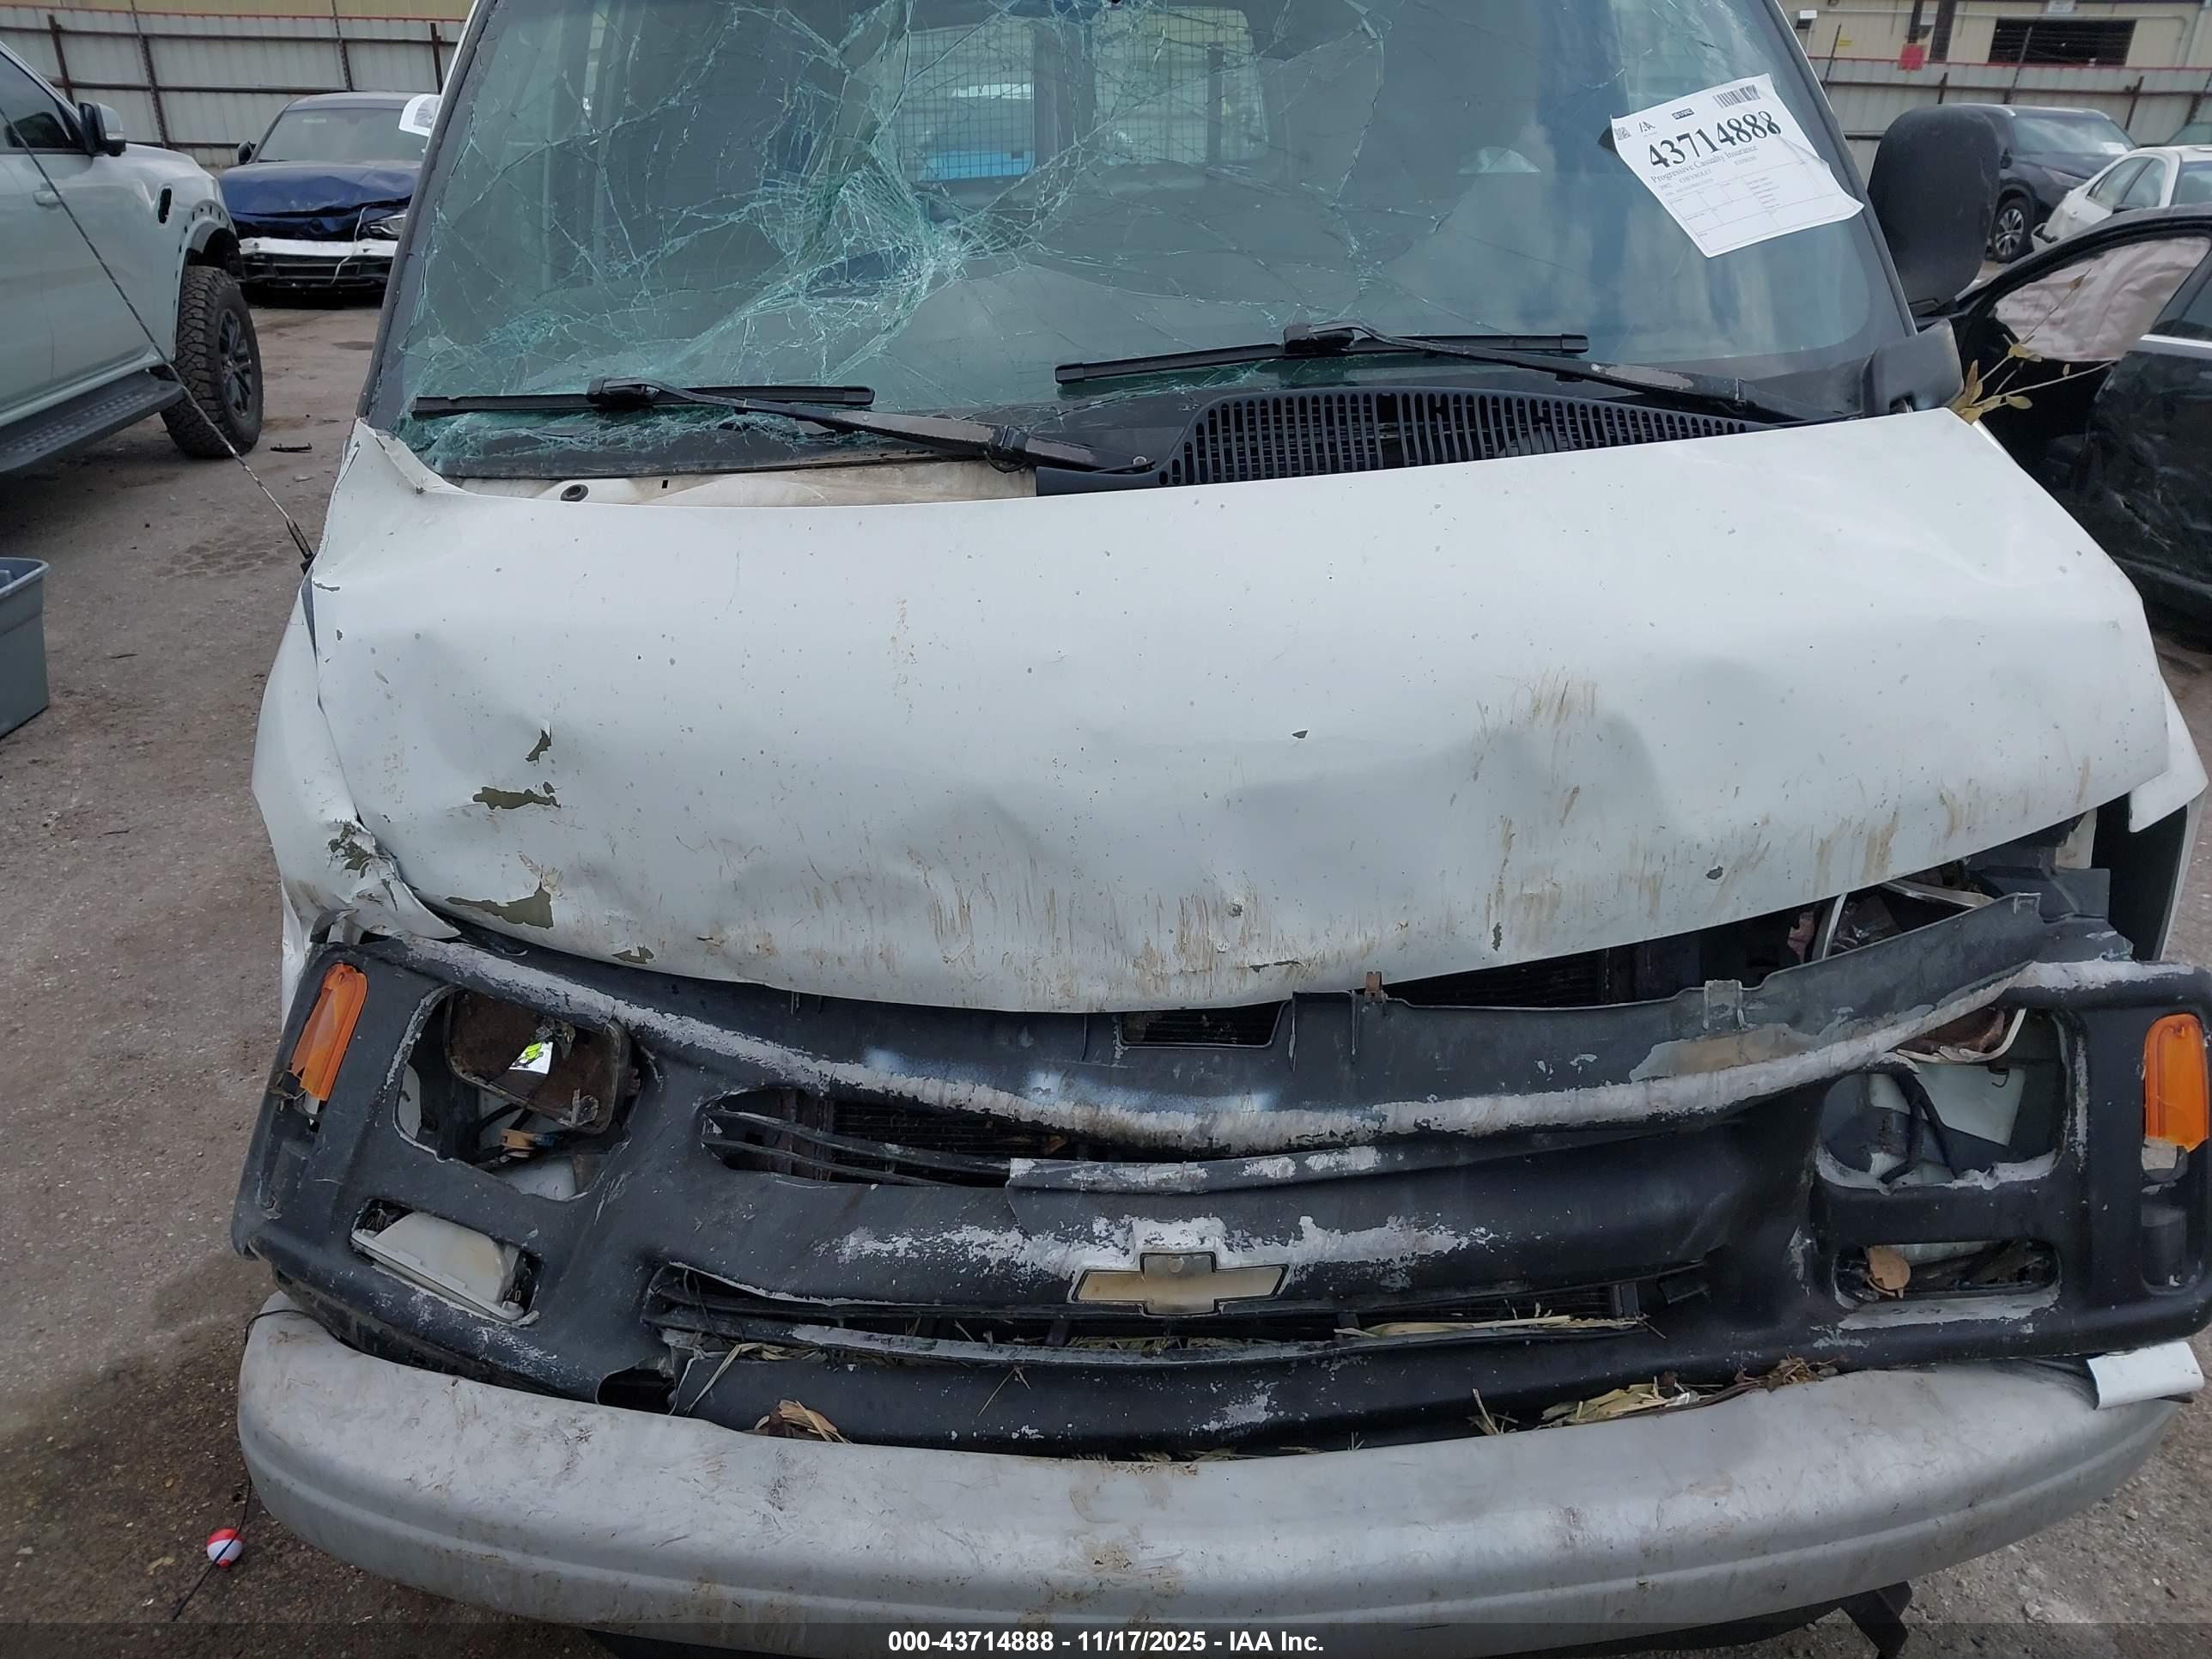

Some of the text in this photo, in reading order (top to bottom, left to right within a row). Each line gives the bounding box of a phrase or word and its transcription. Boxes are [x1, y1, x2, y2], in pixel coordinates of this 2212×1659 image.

[1648, 110, 1782, 168] 43714888
[1650, 145, 1759, 184] Progressive Casualty Insurance
